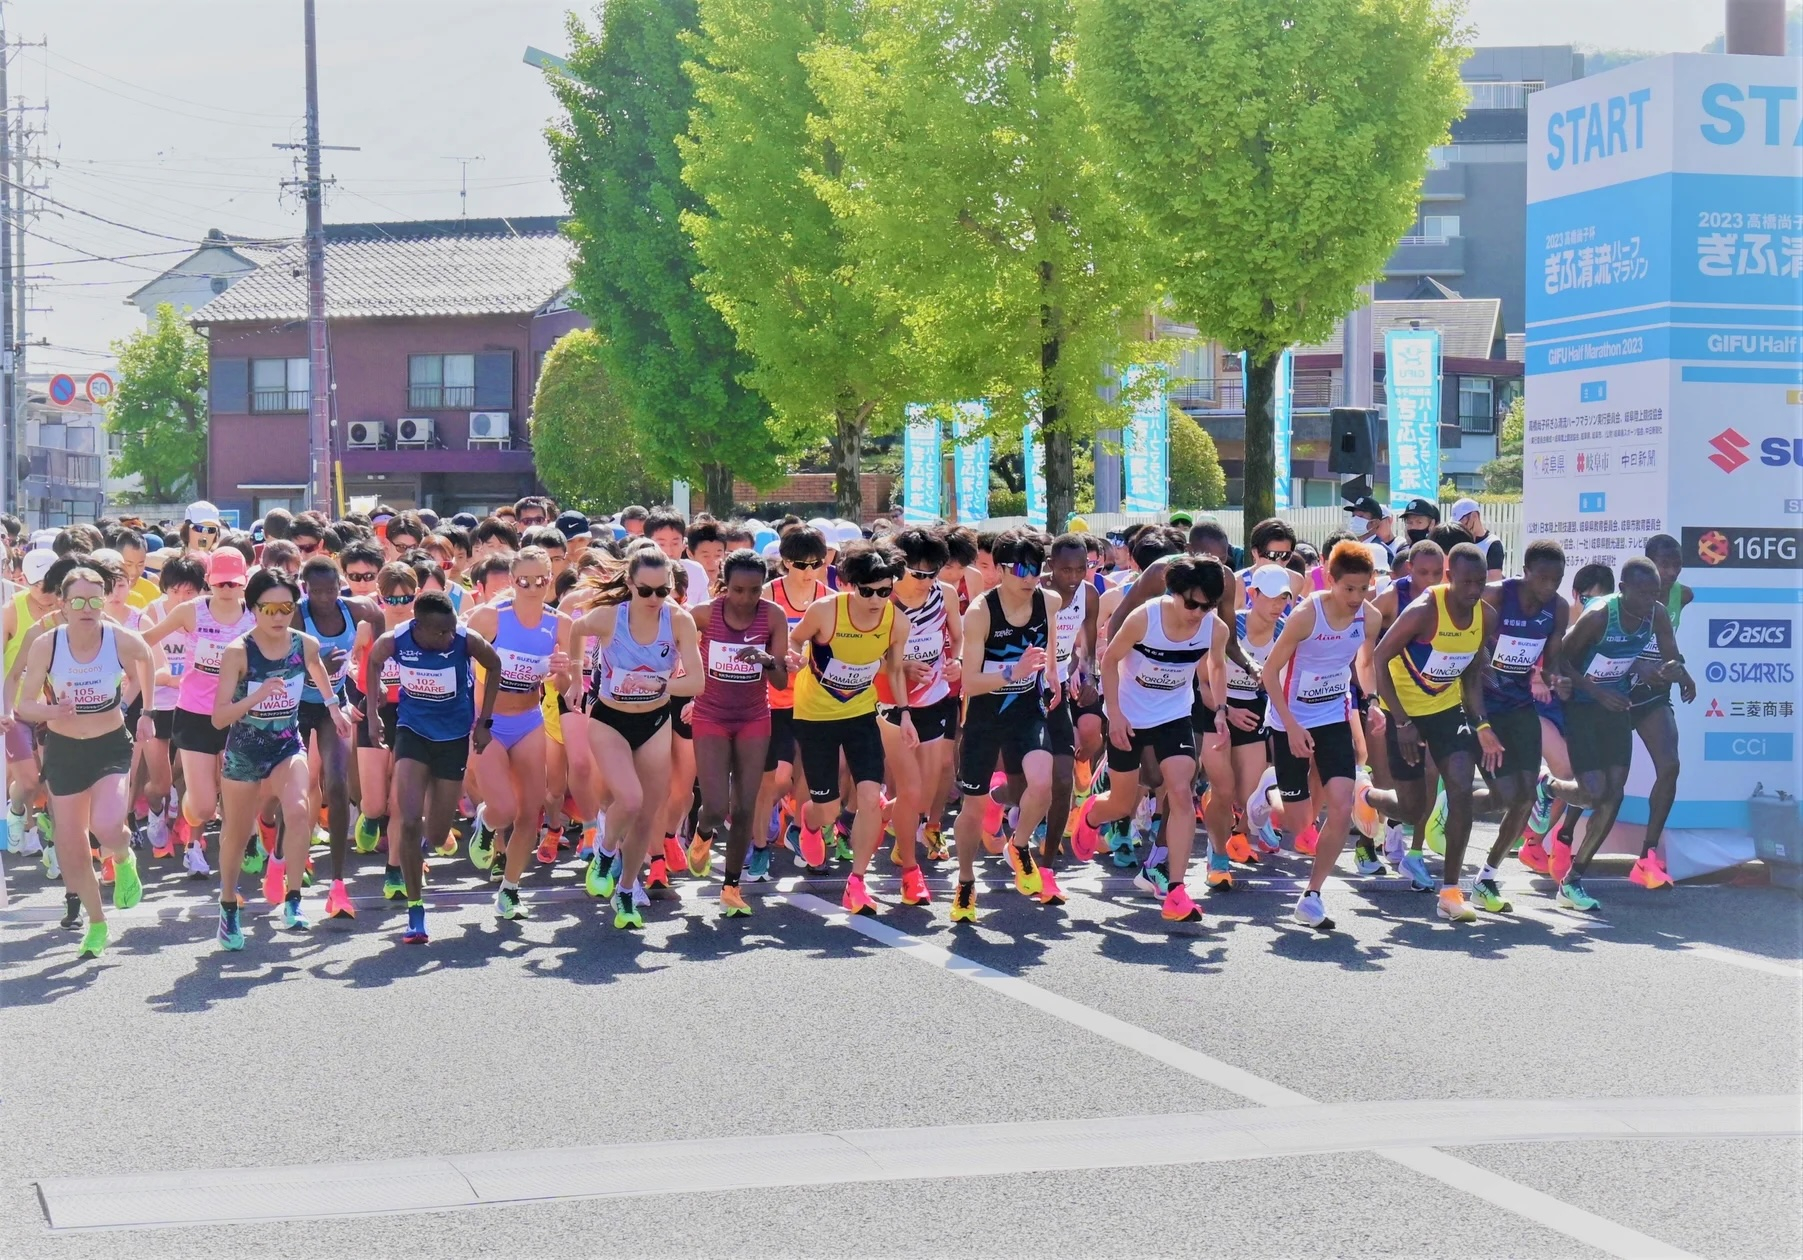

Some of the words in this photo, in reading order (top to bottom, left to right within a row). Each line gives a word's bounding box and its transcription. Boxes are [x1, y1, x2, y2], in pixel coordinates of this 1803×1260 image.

[1700, 82, 1803, 146] ST
[1547, 88, 1650, 171] START
[1697, 212, 1744, 229] 2023
[1545, 232, 1563, 249] 2023
[1612, 236, 1640, 260] ハーフ
[1545, 243, 1612, 295] ぎふ清流
[1612, 258, 1649, 283] マラソン
[1548, 347, 1567, 365] GIFU
[1567, 345, 1584, 362] Half
[1584, 341, 1622, 359] Marathon
[1622, 337, 1643, 354] 2023
[1707, 334, 1757, 352] GIFU
[1759, 335, 1797, 353] Half
[91, 381, 108, 396] 50
[1541, 455, 1565, 475] 岐阜県
[1586, 452, 1609, 472] 岐阜市
[1621, 449, 1656, 469] 中日新聞
[1733, 536, 1797, 560] 16FG
[1739, 626, 1785, 643] asics
[163, 643, 186, 654] AN
[1519, 648, 1526, 656] 2
[68, 665, 103, 675] saucony
[514, 663, 533, 674] 122
[715, 662, 755, 672] DIBABA
[416, 678, 436, 686] 102
[1141, 673, 1186, 685] YOROIZA
[1230, 678, 1257, 686] KOGA
[74, 687, 94, 696] 105
[408, 683, 446, 693] OMARE
[1302, 683, 1346, 697] TOMIYASU
[260, 697, 295, 710] IWADE
[1730, 700, 1794, 718] 三菱商事
[1732, 738, 1766, 756] CCi
